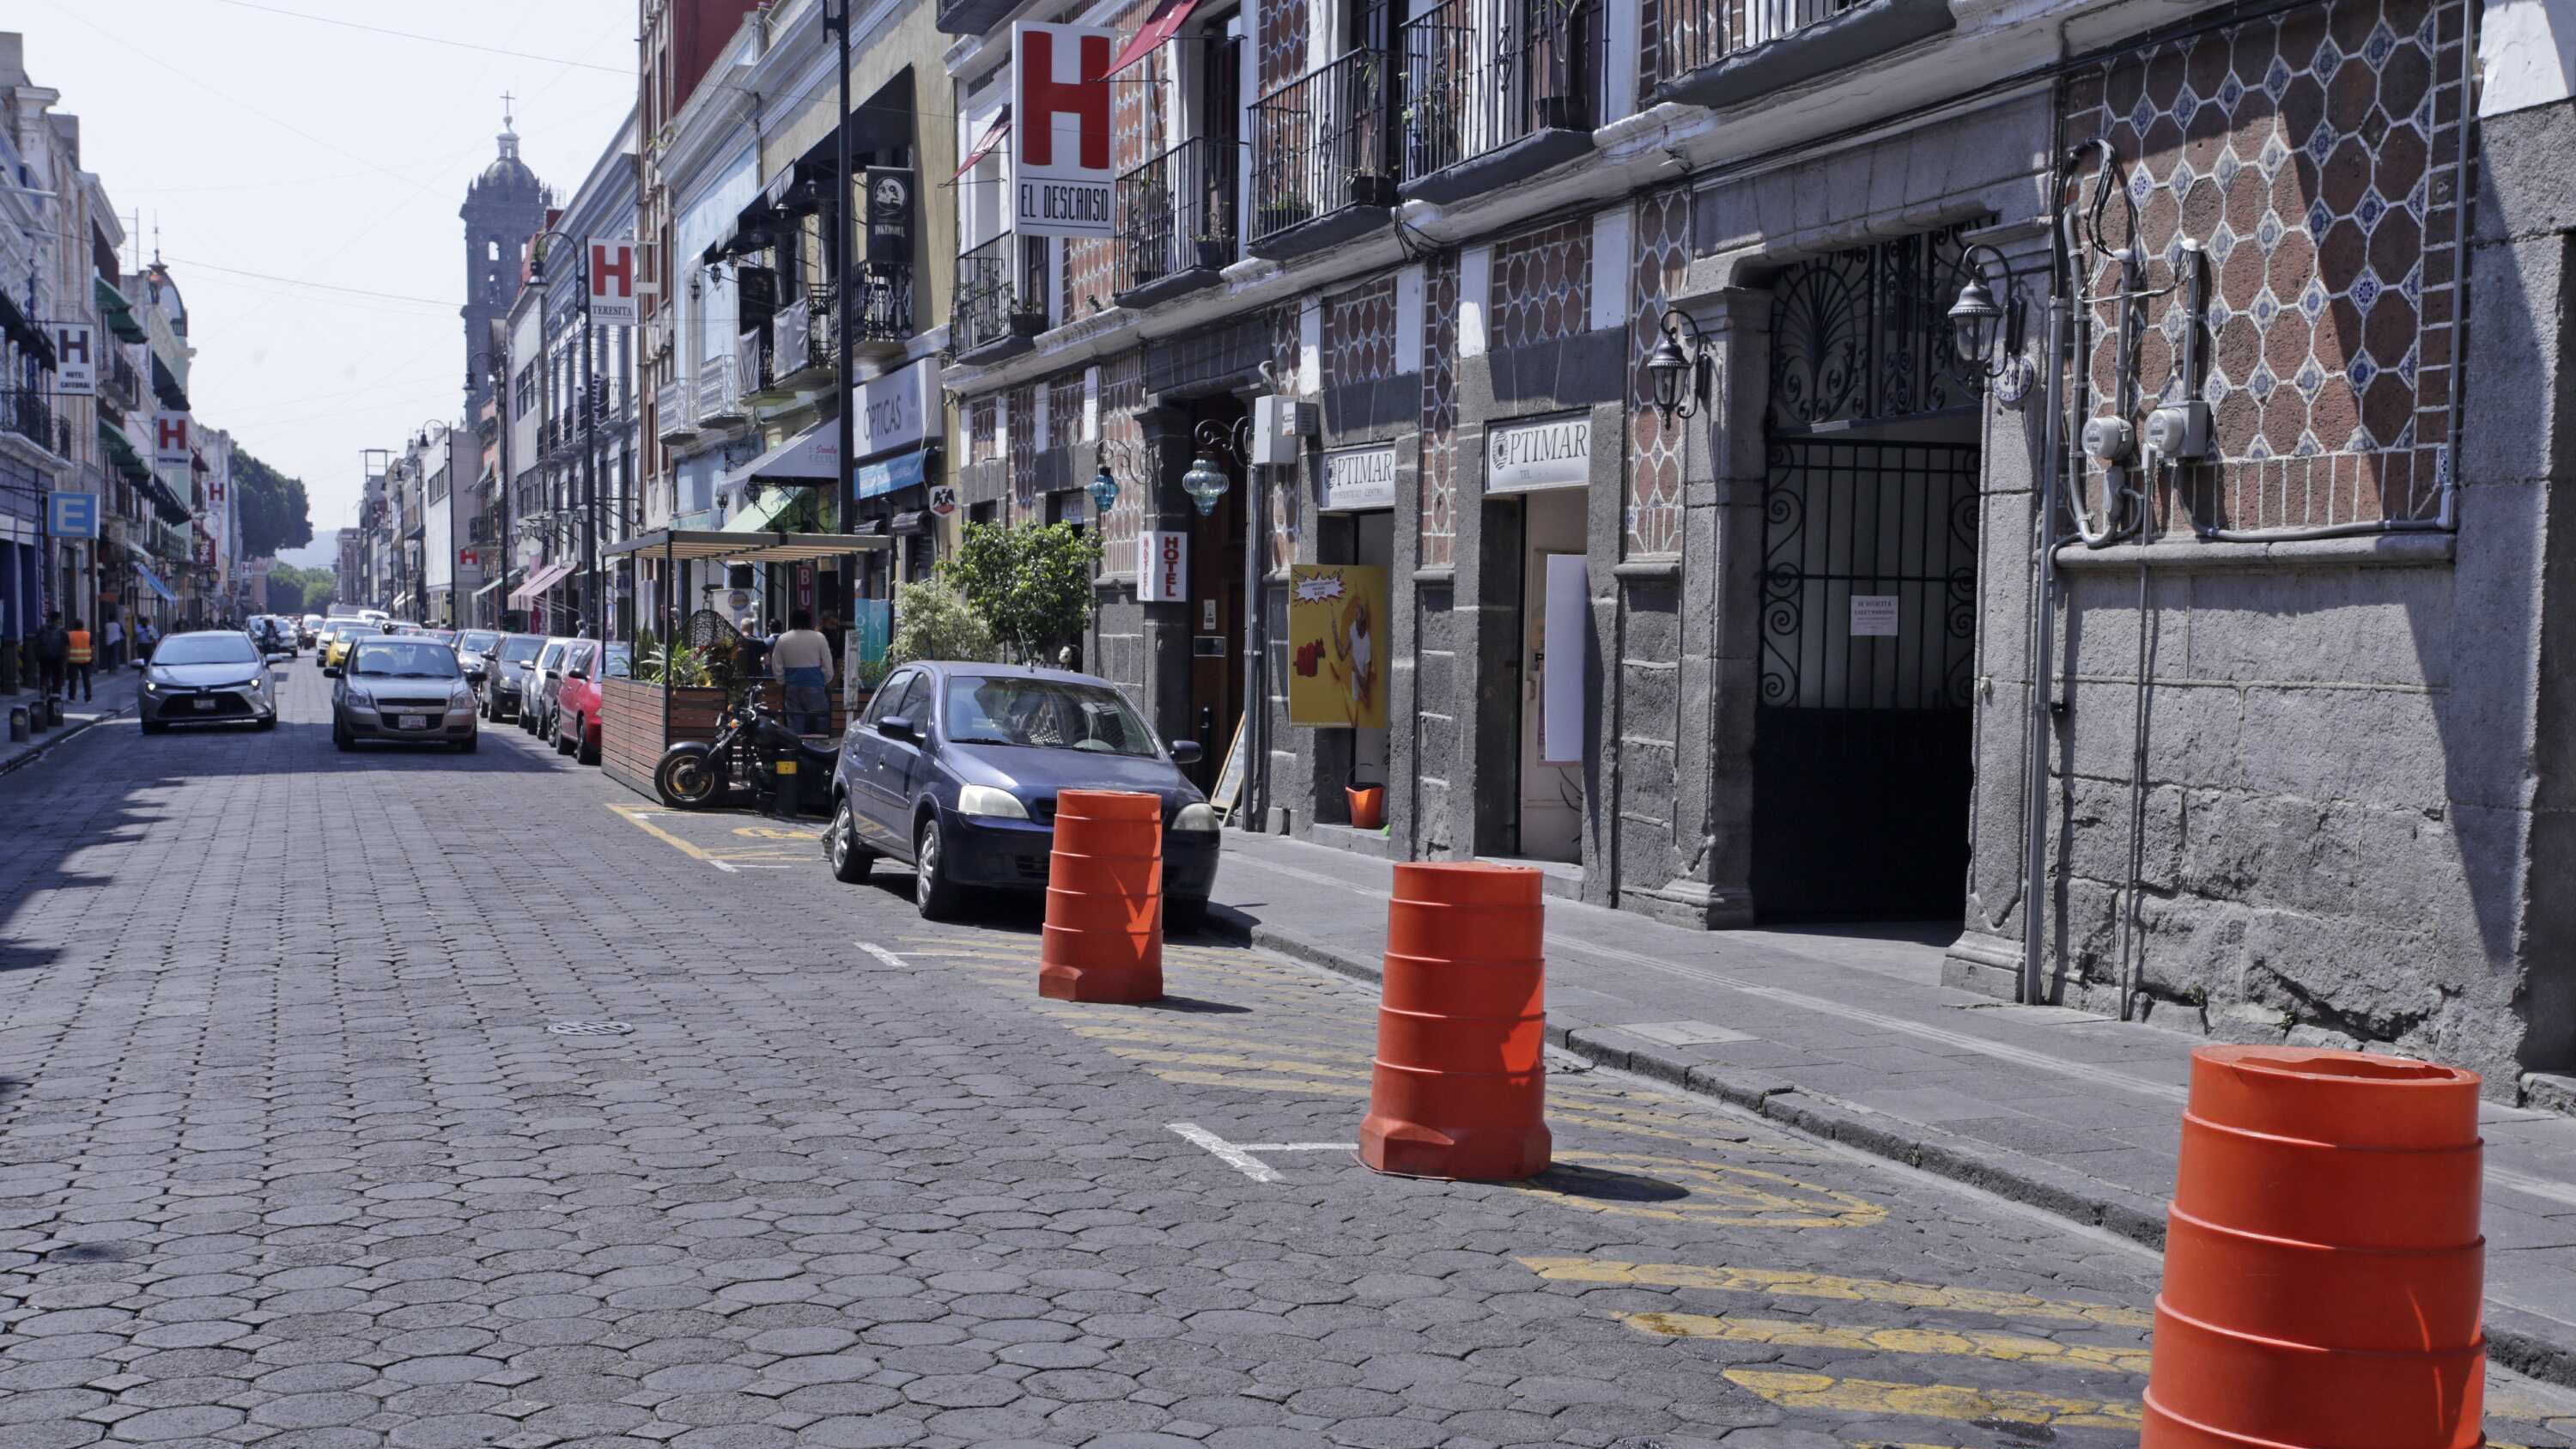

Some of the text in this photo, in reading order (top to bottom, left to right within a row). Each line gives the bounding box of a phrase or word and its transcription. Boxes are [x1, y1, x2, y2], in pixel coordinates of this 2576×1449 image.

[1023, 31, 1109, 169] H
[1021, 184, 1109, 222] EL DESCANSO
[592, 246, 631, 297] H
[592, 306, 632, 316] TERESITA
[58, 329, 89, 363] H
[2004, 369, 2020, 386] 319
[864, 395, 901, 440] OPTICAS
[160, 419, 186, 450] H
[210, 483, 223, 501] H
[57, 499, 87, 532] E
[459, 549, 477, 564] H
[1163, 537, 1179, 597] HOTEL
